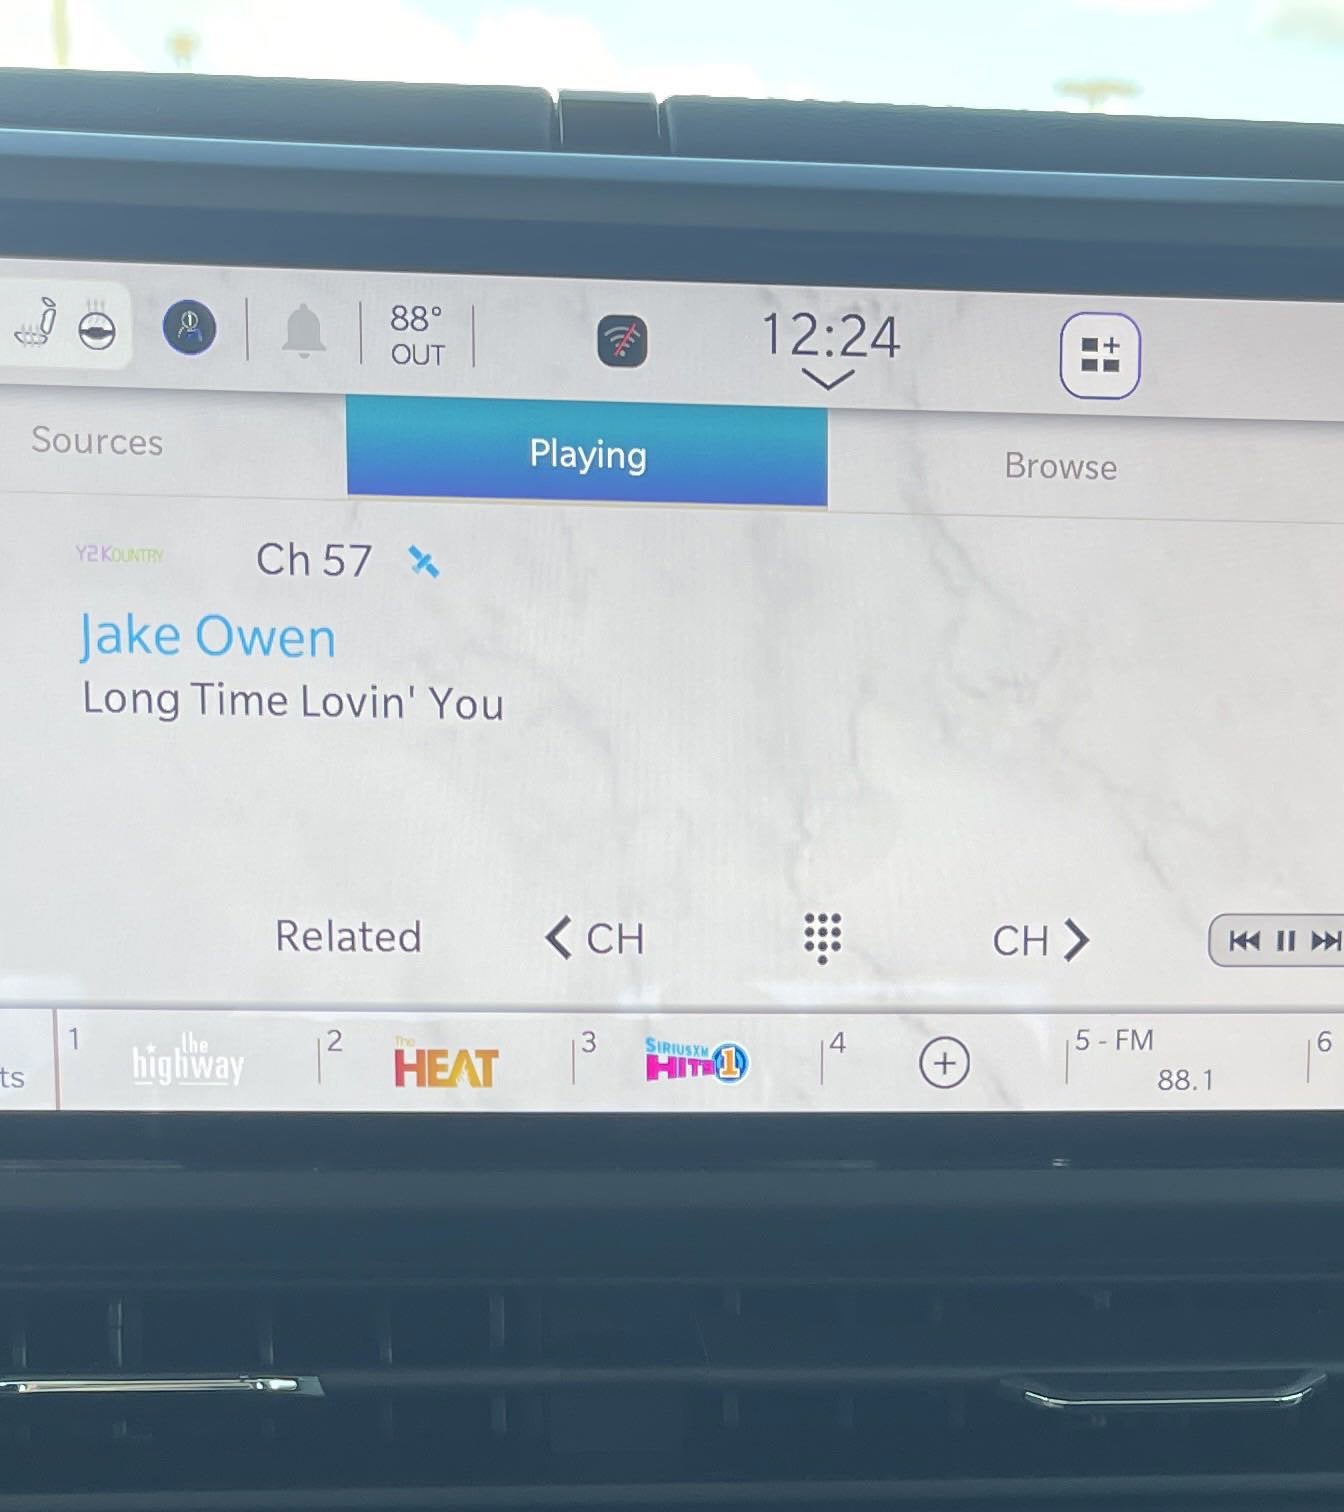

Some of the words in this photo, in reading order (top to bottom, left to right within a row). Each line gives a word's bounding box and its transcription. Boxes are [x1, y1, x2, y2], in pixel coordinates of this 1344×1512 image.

[763, 312, 901, 359] 12:24
[391, 342, 445, 367] OUT
[32, 425, 163, 457] Sources
[530, 437, 647, 475] Playing
[1005, 451, 1118, 482] Browse
[257, 541, 311, 577] Ch
[322, 544, 372, 578] 57
[79, 612, 181, 663] Jake
[196, 614, 336, 659] Owen
[83, 681, 180, 722] Long
[190, 682, 288, 718] Time
[301, 683, 415, 720] Lovin'
[428, 687, 504, 722] You
[277, 918, 422, 954] Related
[587, 922, 644, 956] CH
[994, 924, 1047, 958] CH
[69, 1028, 79, 1051] 1
[182, 1031, 208, 1053] the
[327, 1029, 343, 1053] 2
[581, 1031, 597, 1055] 3
[829, 1031, 846, 1054] 4
[1075, 1029, 1088, 1053] 5
[1116, 1029, 1154, 1053] FM
[1316, 1031, 1332, 1053] 6
[132, 1043, 244, 1086] highway
[394, 1049, 500, 1087] HEAT
[1158, 1069, 1215, 1092] 88.1
